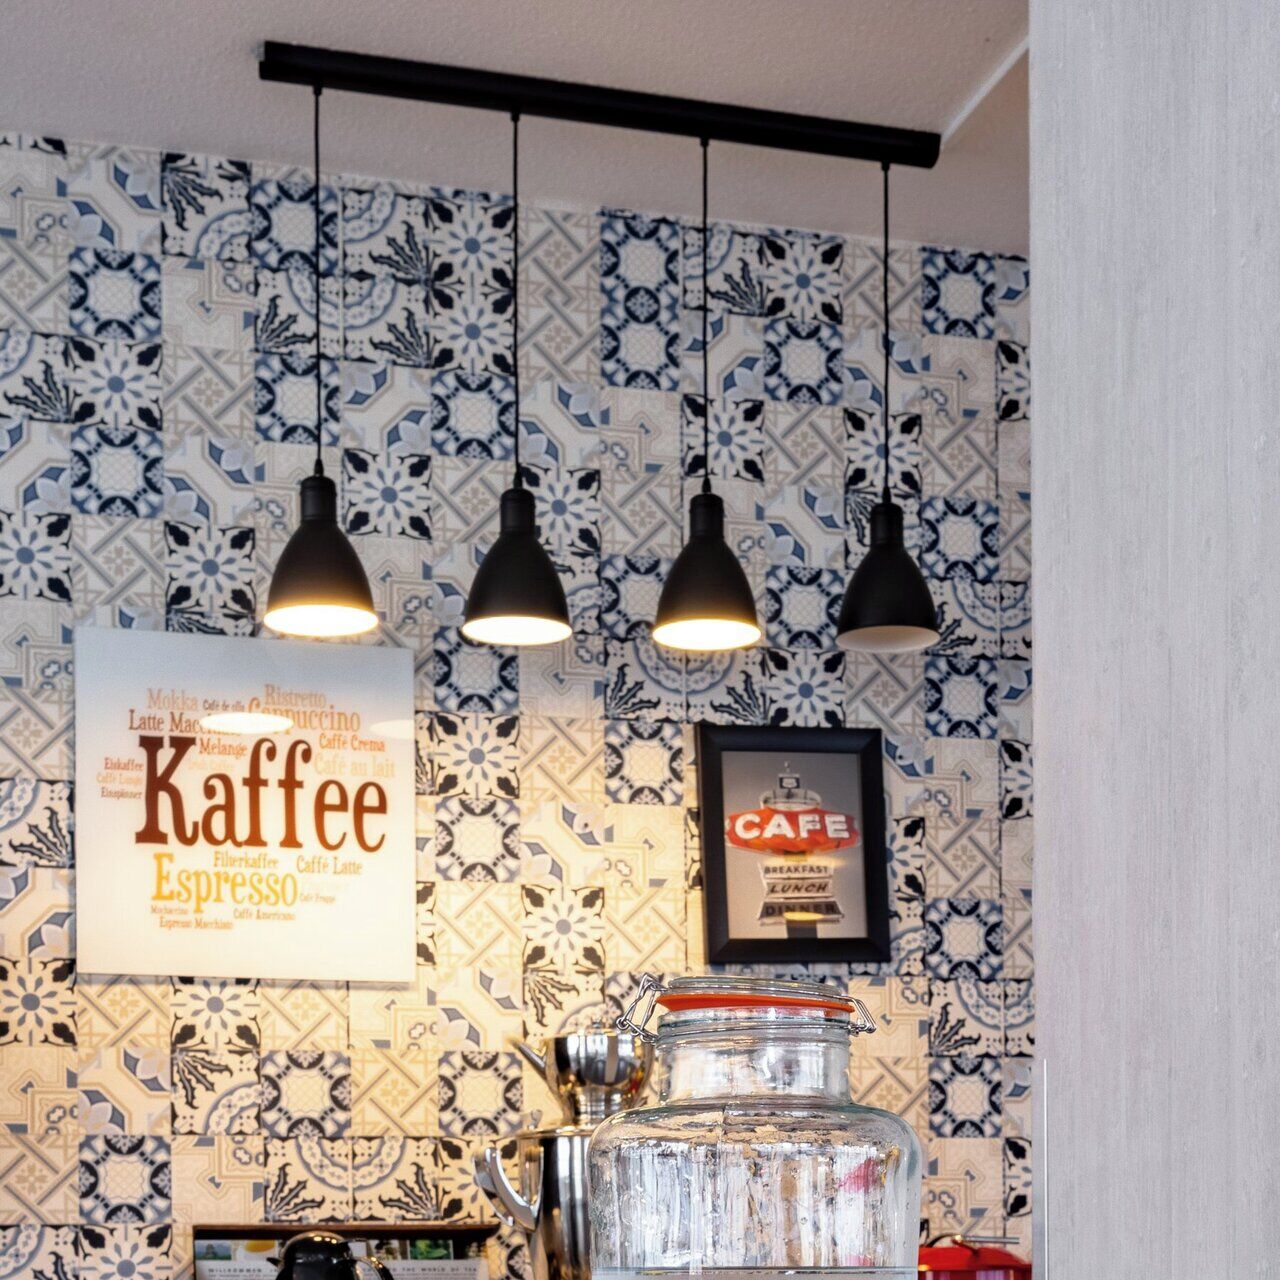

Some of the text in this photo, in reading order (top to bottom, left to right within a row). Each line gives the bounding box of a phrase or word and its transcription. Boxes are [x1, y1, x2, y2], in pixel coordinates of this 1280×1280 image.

[147, 688, 198, 711] Mokka
[128, 708, 164, 731] Latte
[351, 735, 385, 751] Crema
[135, 735, 388, 853] Kaffee
[734, 813, 850, 840] CAFE
[333, 857, 363, 875] Latte
[764, 866, 829, 874] BREAKFAST
[151, 852, 298, 914] Espresso
[770, 883, 828, 894] LUNCH
[765, 904, 836, 916] DINNER
